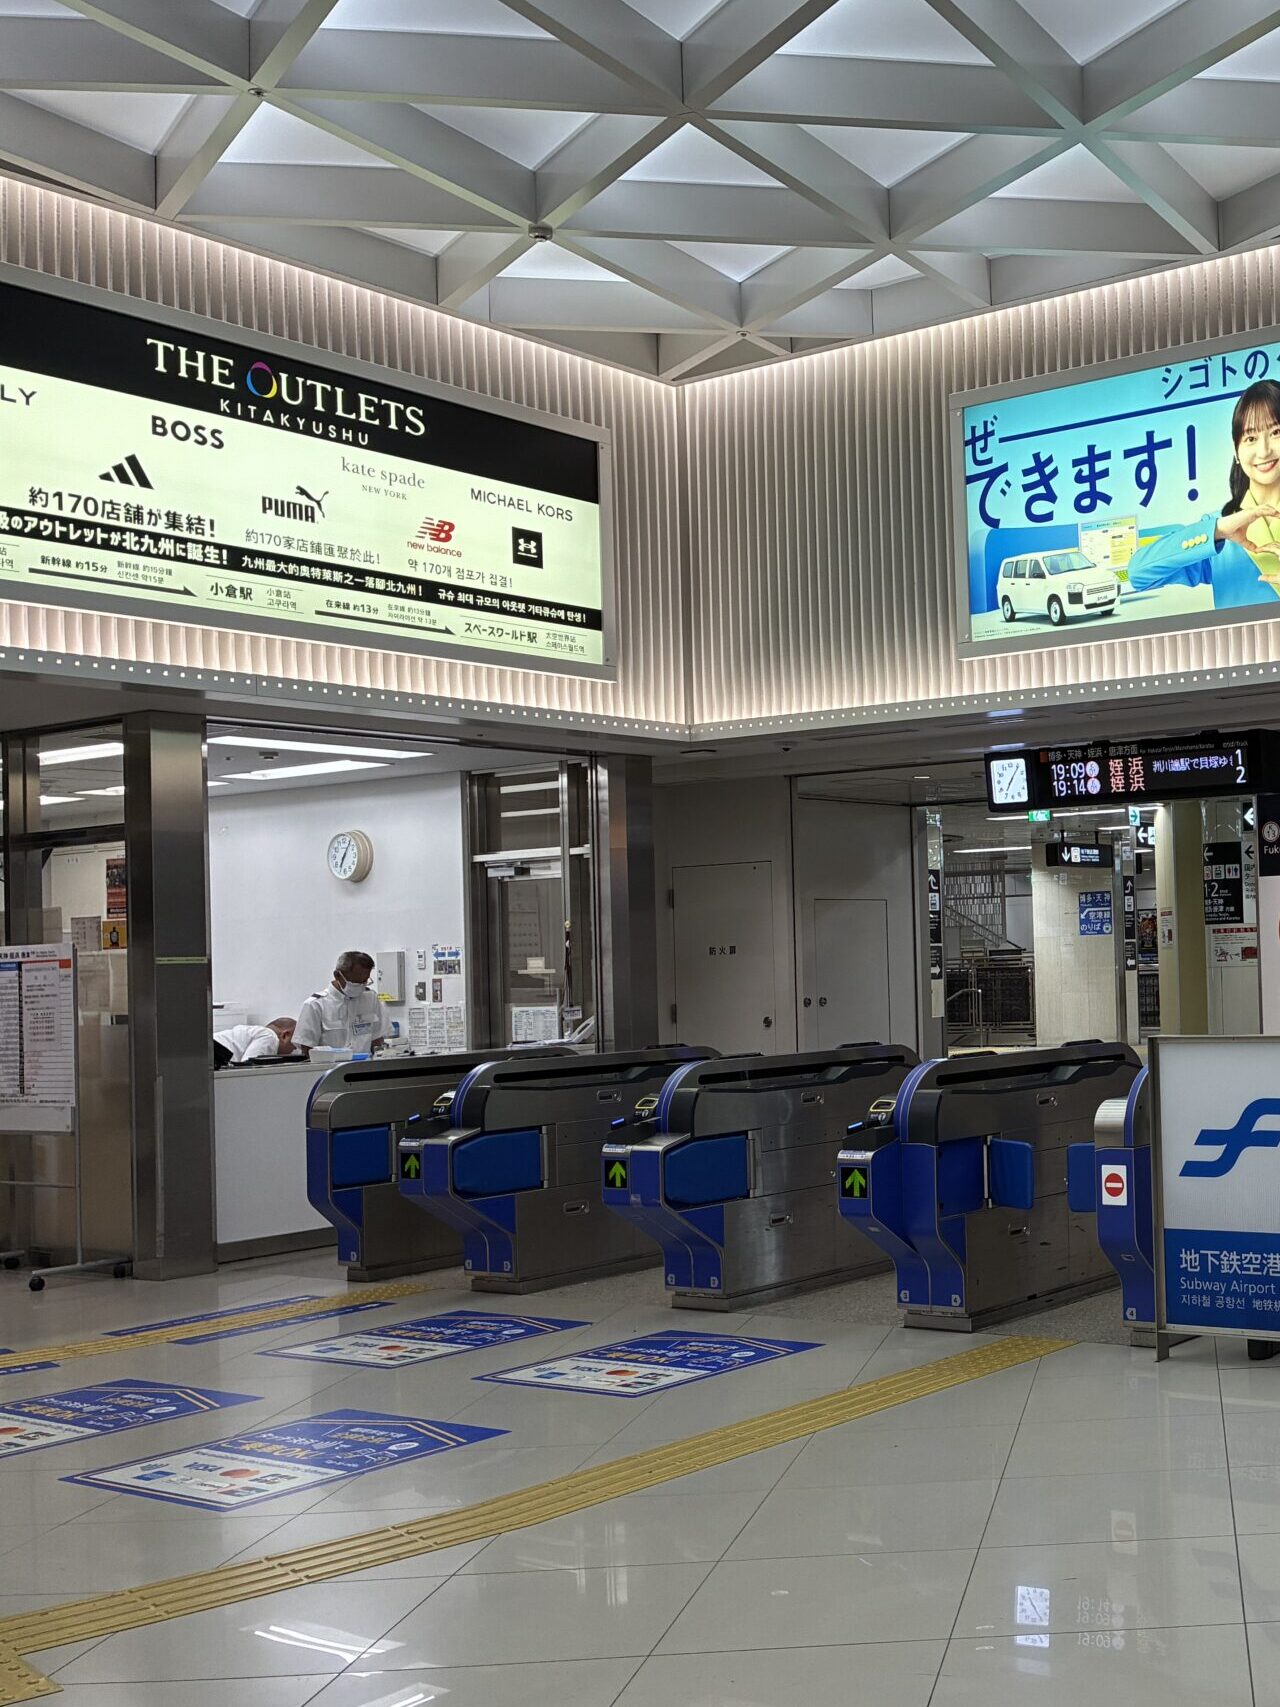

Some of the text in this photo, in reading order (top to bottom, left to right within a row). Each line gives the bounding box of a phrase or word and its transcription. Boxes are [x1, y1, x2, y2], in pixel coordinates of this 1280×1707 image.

[147, 338, 426, 436] THE OUTLETS
[219, 398, 369, 446] KITAKYUSHU
[151, 414, 225, 450] BOSS
[341, 456, 426, 490] kate spade
[361, 484, 408, 501] NEW YORK
[261, 495, 316, 524] PUMA
[470, 488, 573, 522] MICHAEL KORS
[407, 540, 462, 559] new balance
[40, 555, 108, 574] 新幹線 約15分
[408, 559, 418, 572] 약
[422, 561, 452, 578] 170개
[455, 566, 485, 584] 점포가
[210, 582, 253, 601] 小倉駅
[438, 588, 455, 602] 규슈
[464, 622, 538, 644] スペースワールド駅
[1235, 748, 1242, 765] 1
[1051, 763, 1086, 780] 19:09
[1235, 766, 1247, 783] 2
[1053, 779, 1087, 796] 19:14
[1180, 1276, 1227, 1295] Subway
[1230, 1280, 1276, 1296] Airport
[1181, 1294, 1211, 1308] 지하철
[1215, 1295, 1246, 1310] 공항선
